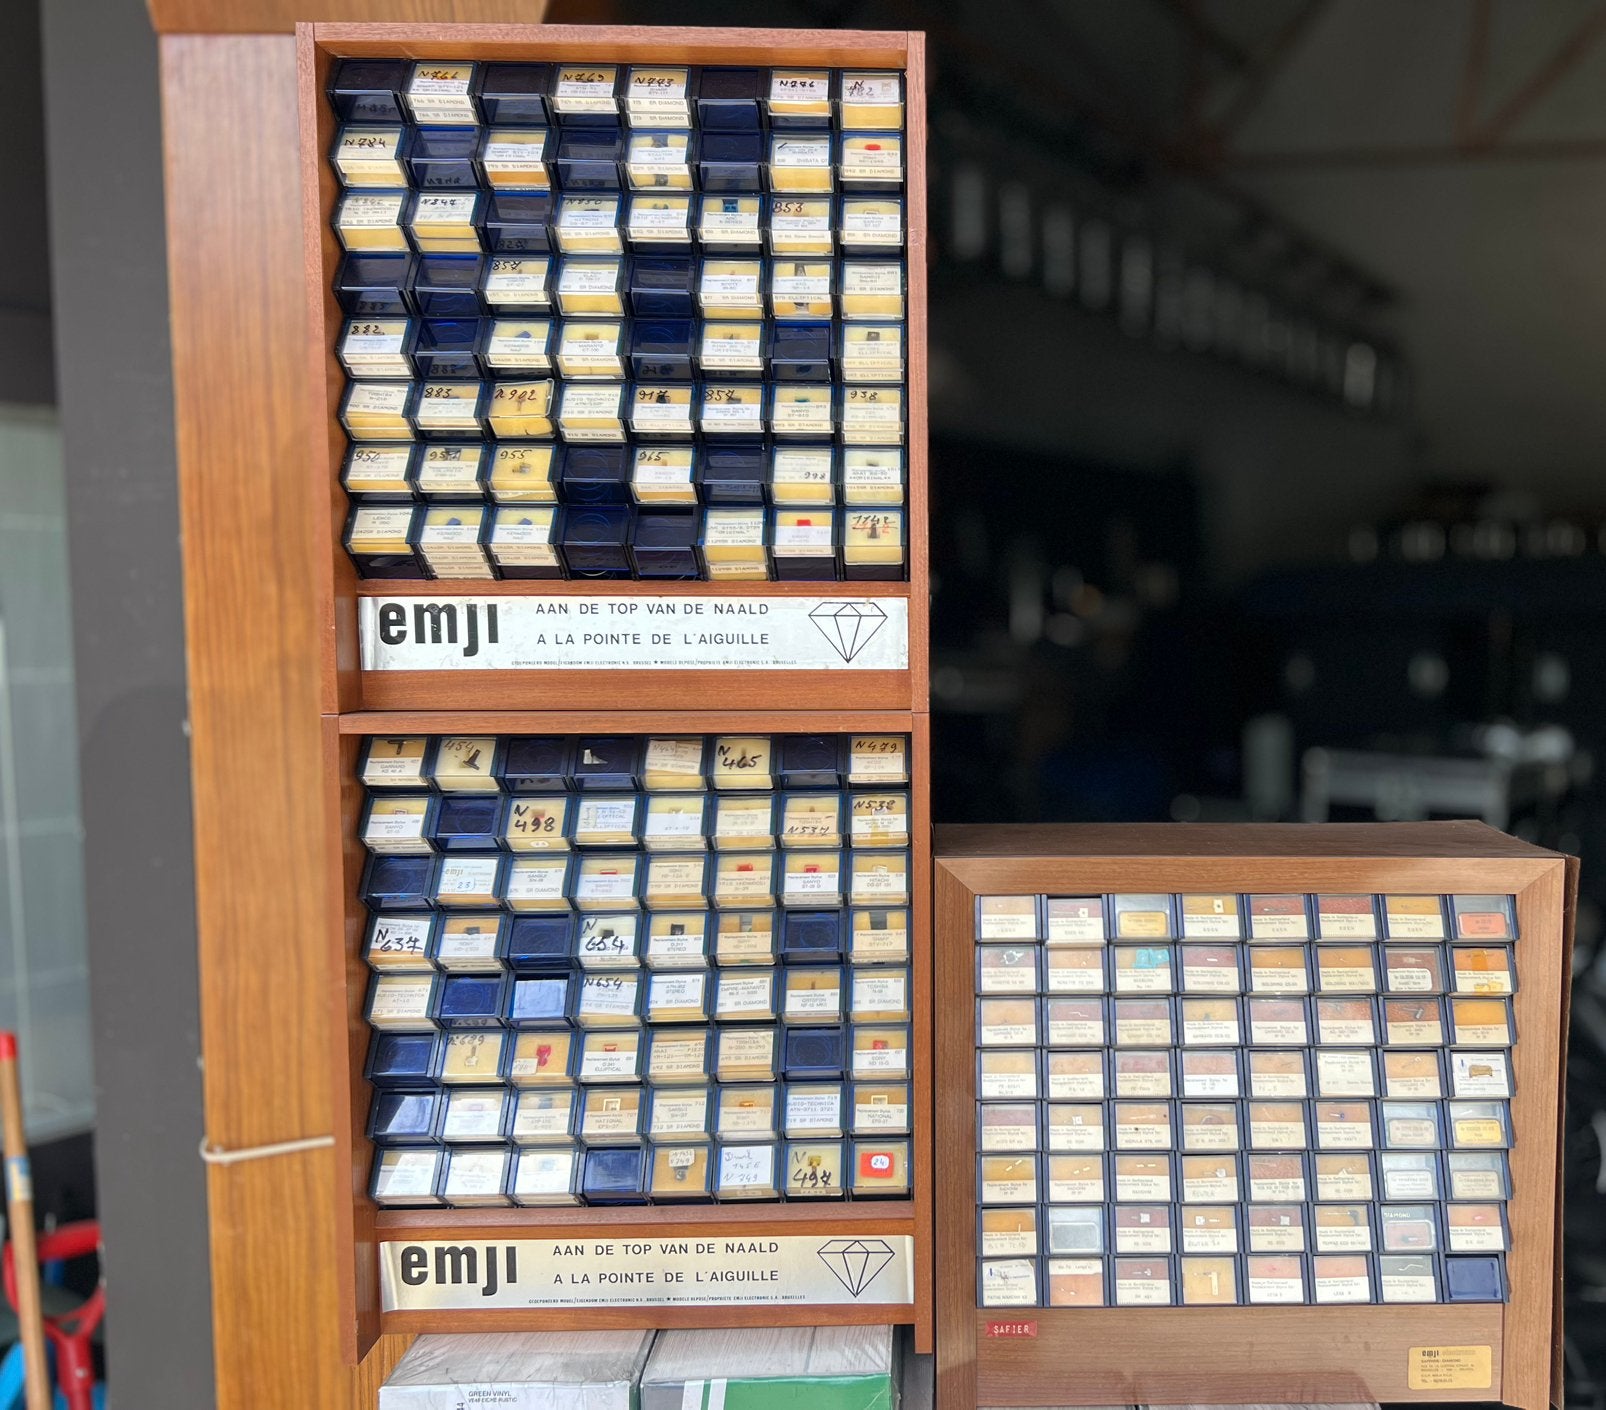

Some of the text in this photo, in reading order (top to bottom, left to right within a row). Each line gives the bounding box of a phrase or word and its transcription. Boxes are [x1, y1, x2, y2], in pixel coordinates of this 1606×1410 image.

[772, 201, 804, 214] 853
[500, 450, 533, 460] 955
[536, 603, 769, 615] AAN DE TOP VAN DE NAALD
[537, 632, 770, 645] A LA POINTE DE L'AIGUILLE
[444, 740, 475, 754] 454
[717, 745, 730, 757] N
[722, 754, 763, 770] 465
[514, 803, 529, 817] N
[514, 817, 556, 834] 498
[379, 935, 424, 955] 637
[583, 976, 623, 989] N654
[743, 998, 769, 1006] DIAMOND
[552, 1242, 780, 1257] AAN DE TOP VAN DE NAALD
[553, 1270, 780, 1285] A LA POINTE DE L'AIGUILLE
[993, 1324, 1030, 1335] SAFIER
[468, 1390, 492, 1398] GREEN
